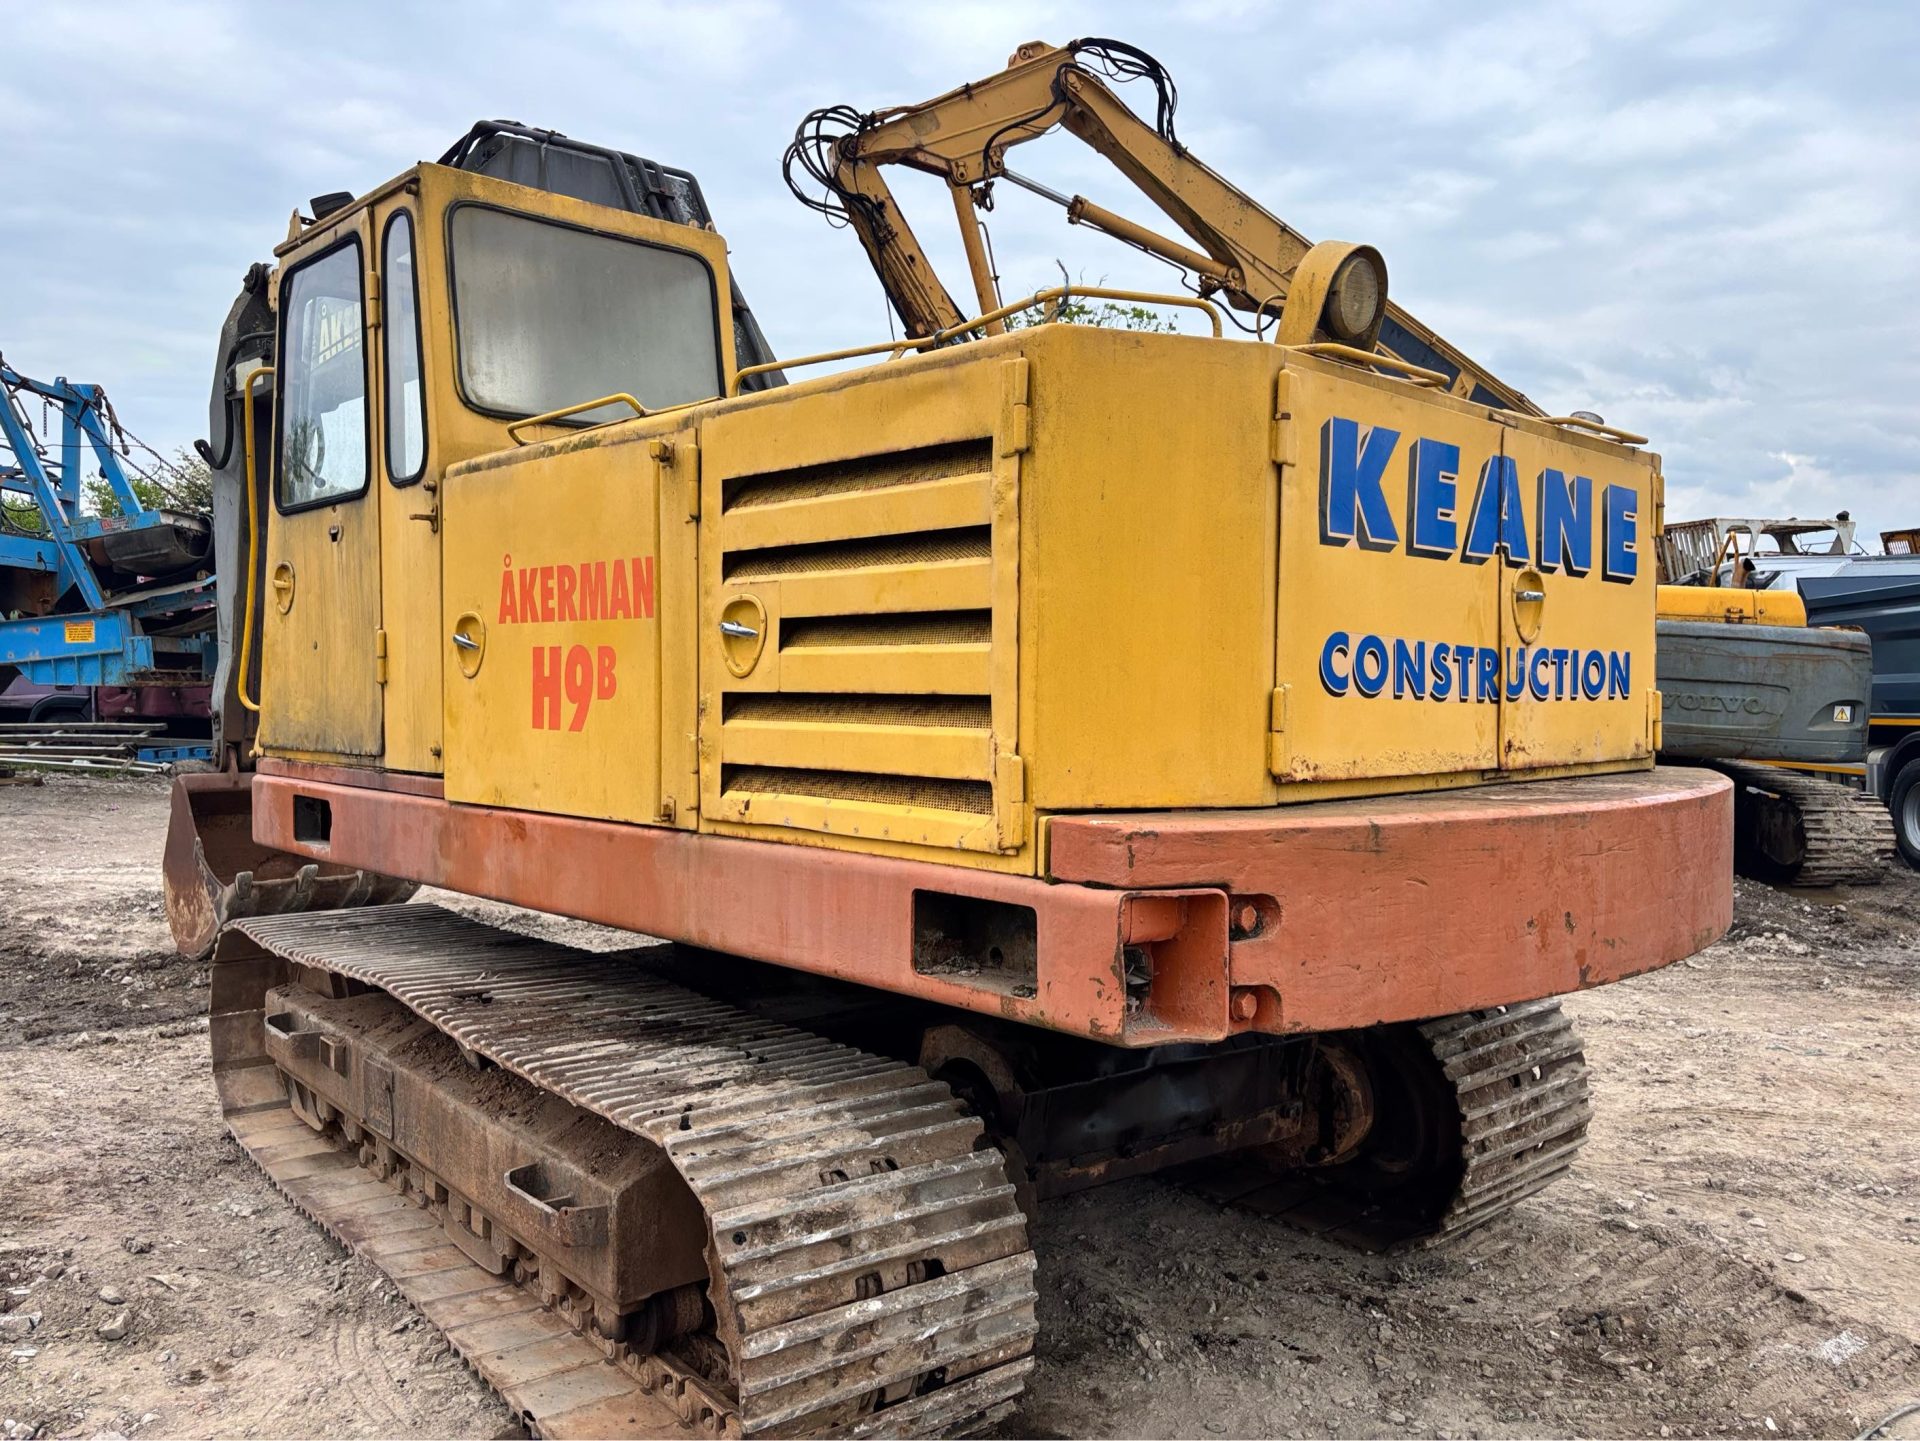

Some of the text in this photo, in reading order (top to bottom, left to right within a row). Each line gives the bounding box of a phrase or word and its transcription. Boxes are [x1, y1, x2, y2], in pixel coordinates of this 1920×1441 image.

[1319, 416, 1638, 586] KEANE
[498, 553, 654, 625] ÅKERMAN
[1319, 631, 1631, 705] CONSTRUCTION
